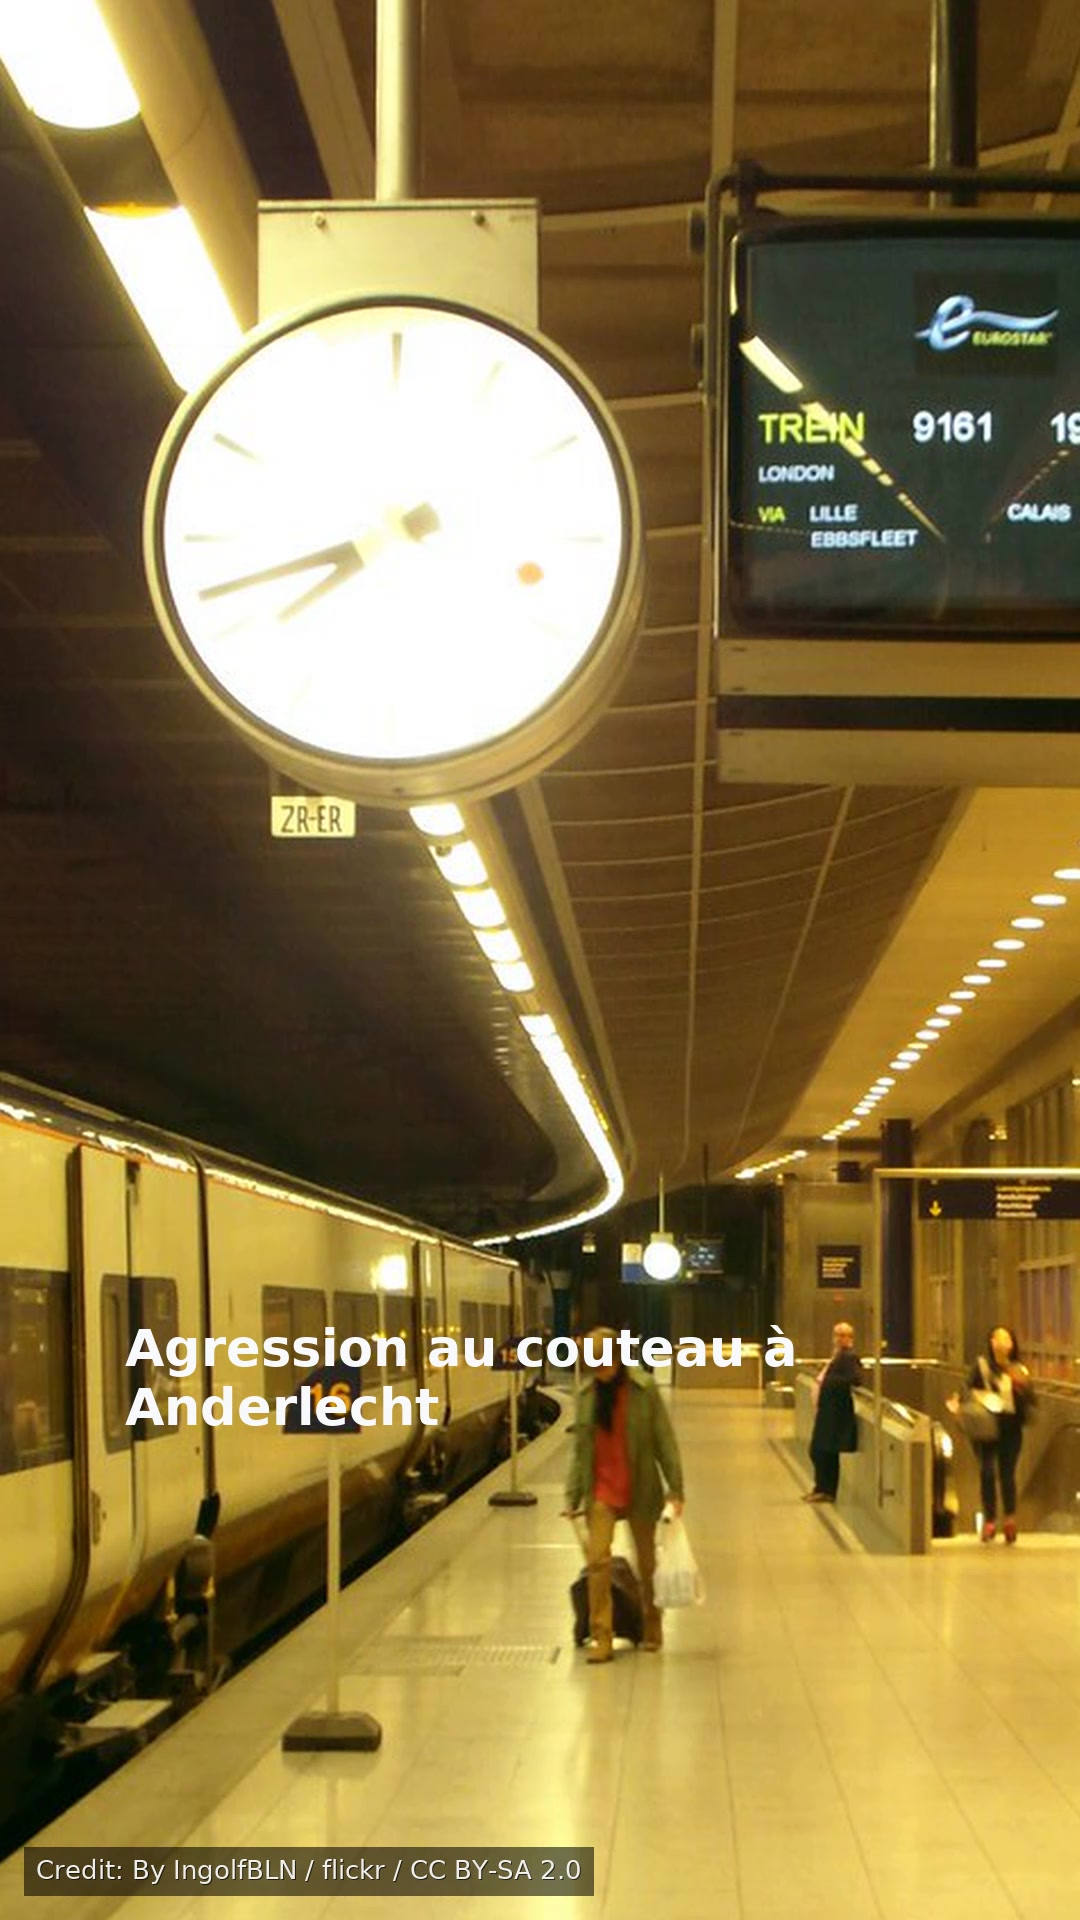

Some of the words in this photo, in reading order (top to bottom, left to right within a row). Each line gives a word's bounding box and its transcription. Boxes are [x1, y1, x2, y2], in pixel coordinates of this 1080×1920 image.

[758, 412, 864, 444] TREIN
[912, 410, 992, 443] 9161
[758, 464, 835, 482] LONDON
[758, 506, 786, 522] VIA
[809, 504, 858, 522] LILLE
[1007, 503, 1072, 522] CALAIS
[810, 529, 918, 548] EBBSFLEET
[280, 804, 343, 833] ZR-ER
